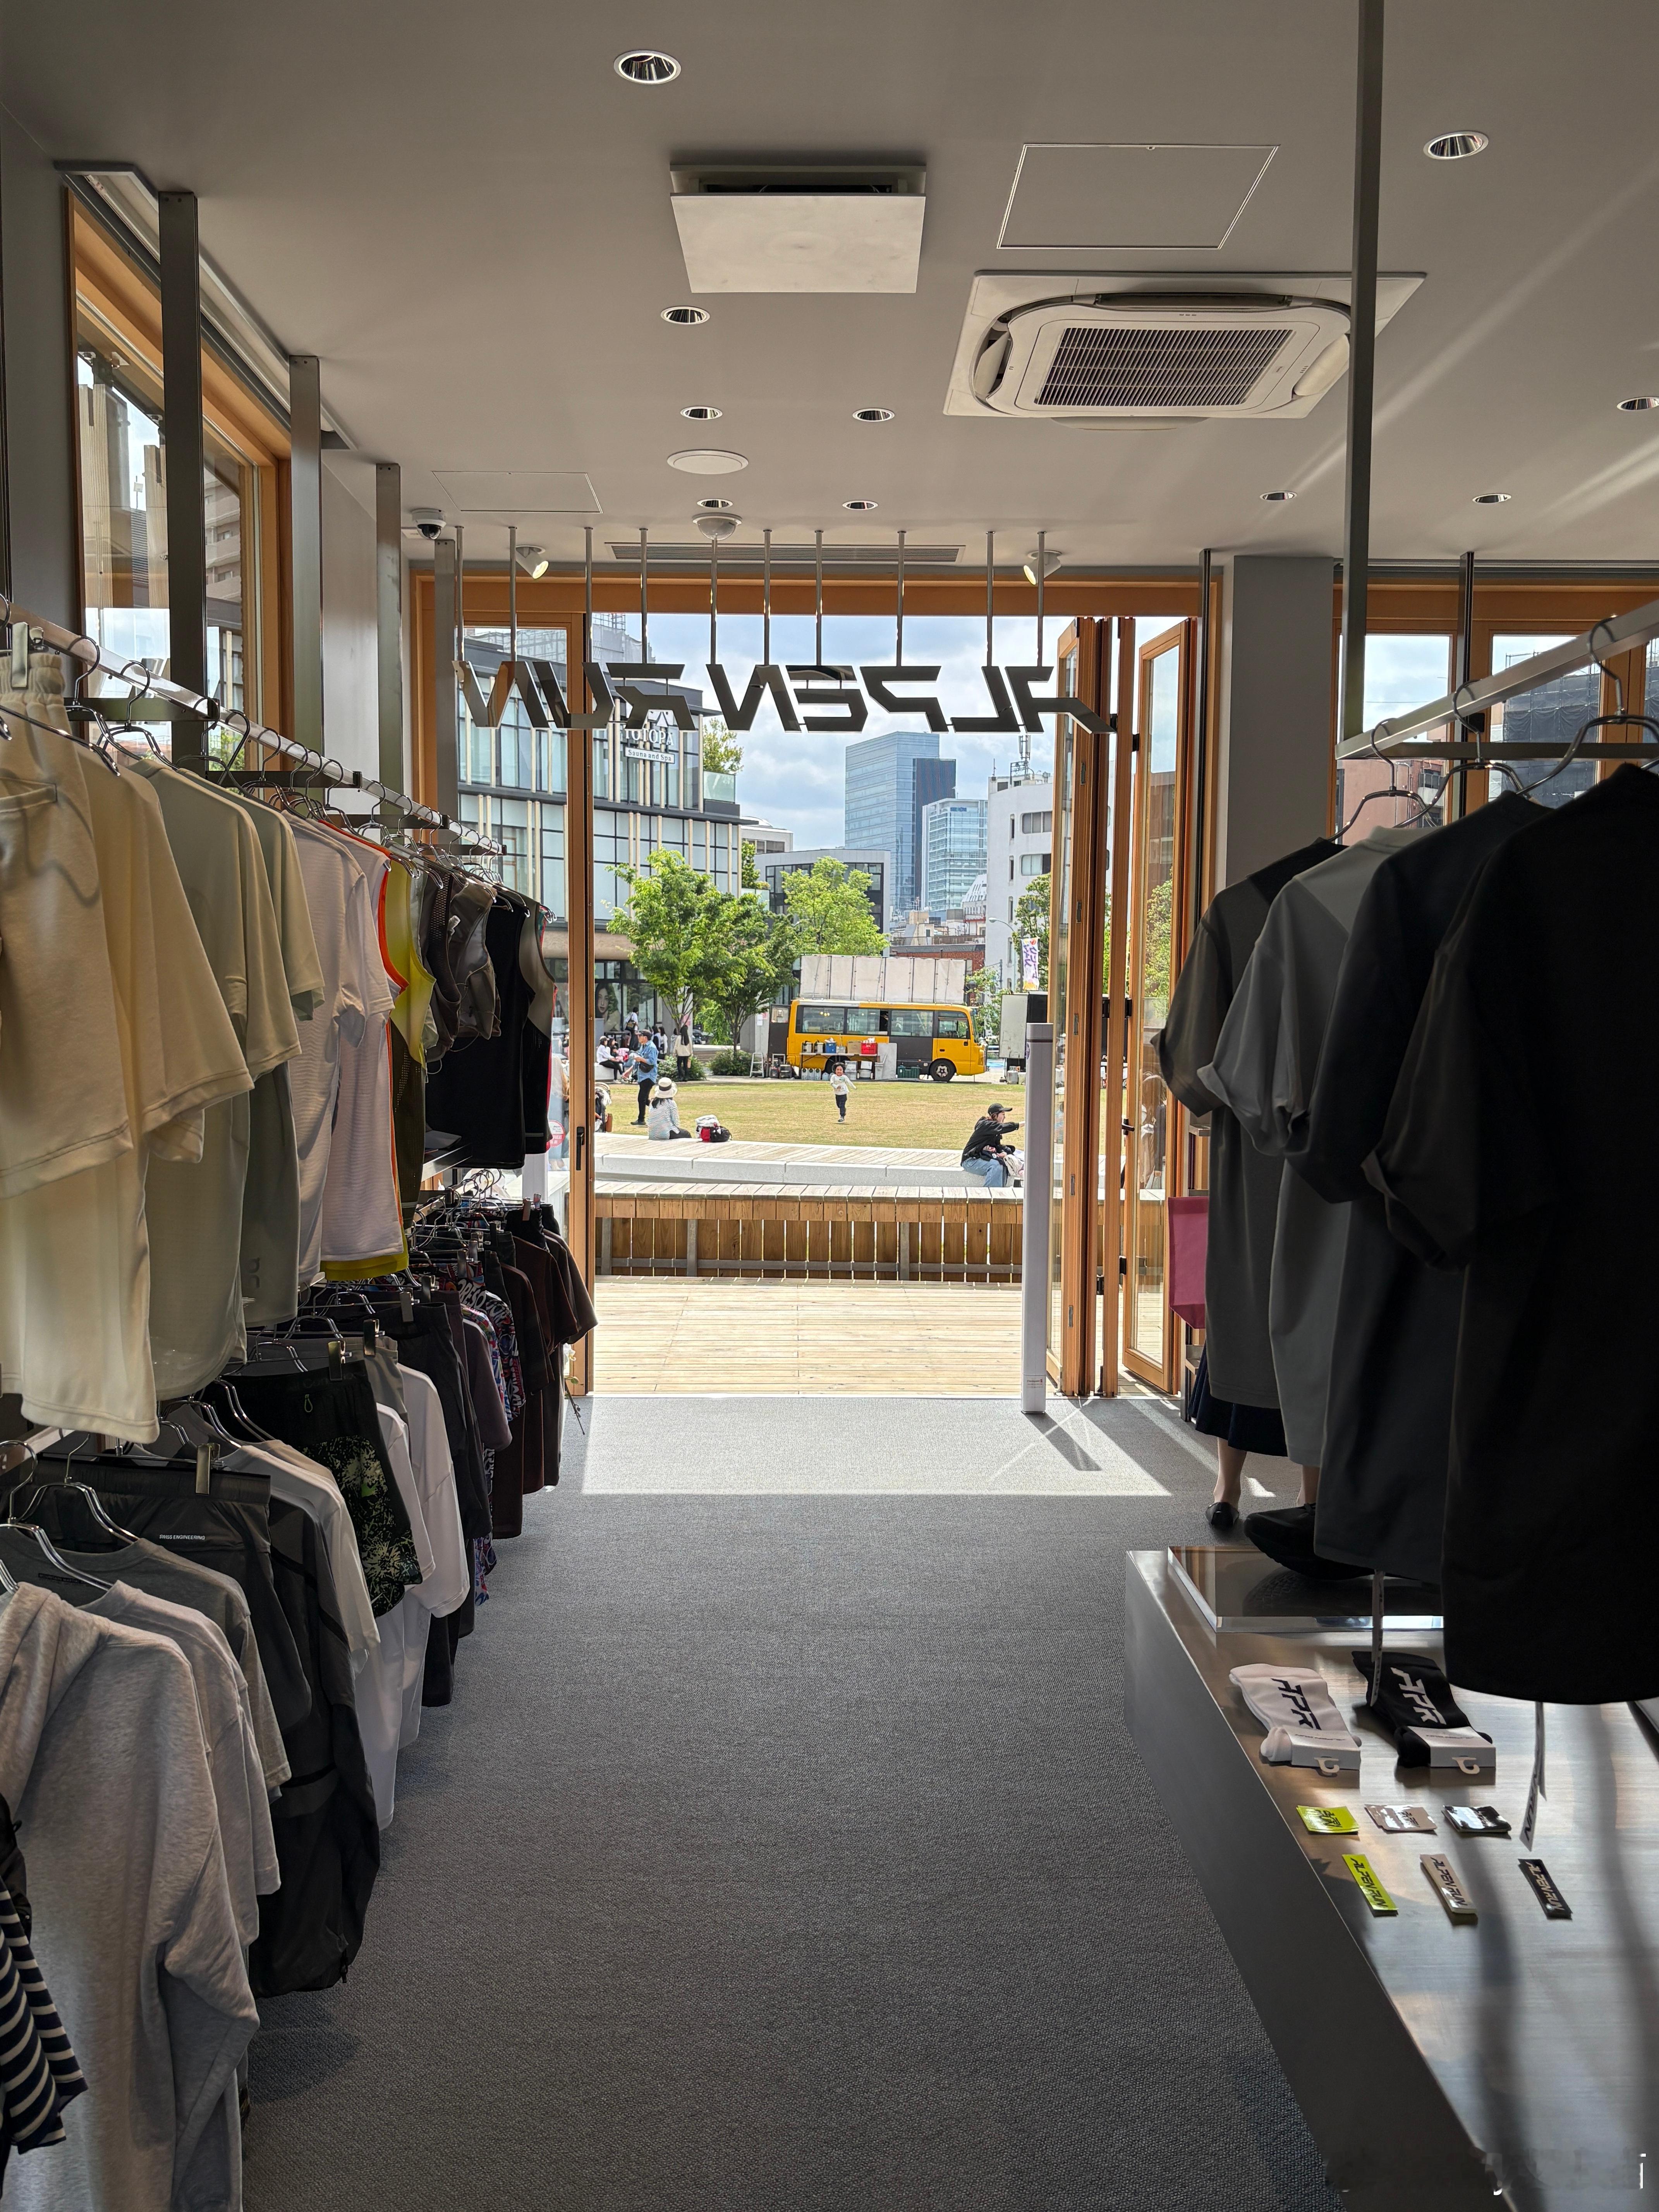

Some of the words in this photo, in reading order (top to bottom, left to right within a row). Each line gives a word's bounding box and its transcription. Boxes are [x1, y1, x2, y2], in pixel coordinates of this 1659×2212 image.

[625, 728, 674, 746] TOTOPA
[1350, 1858, 1377, 1889] ALPEN
[1368, 1889, 1388, 1907] RUN
[1430, 1856, 1457, 1887] ALPEN
[1447, 1887, 1468, 1906] RUN
[1525, 1861, 1553, 1893] ALPEN
